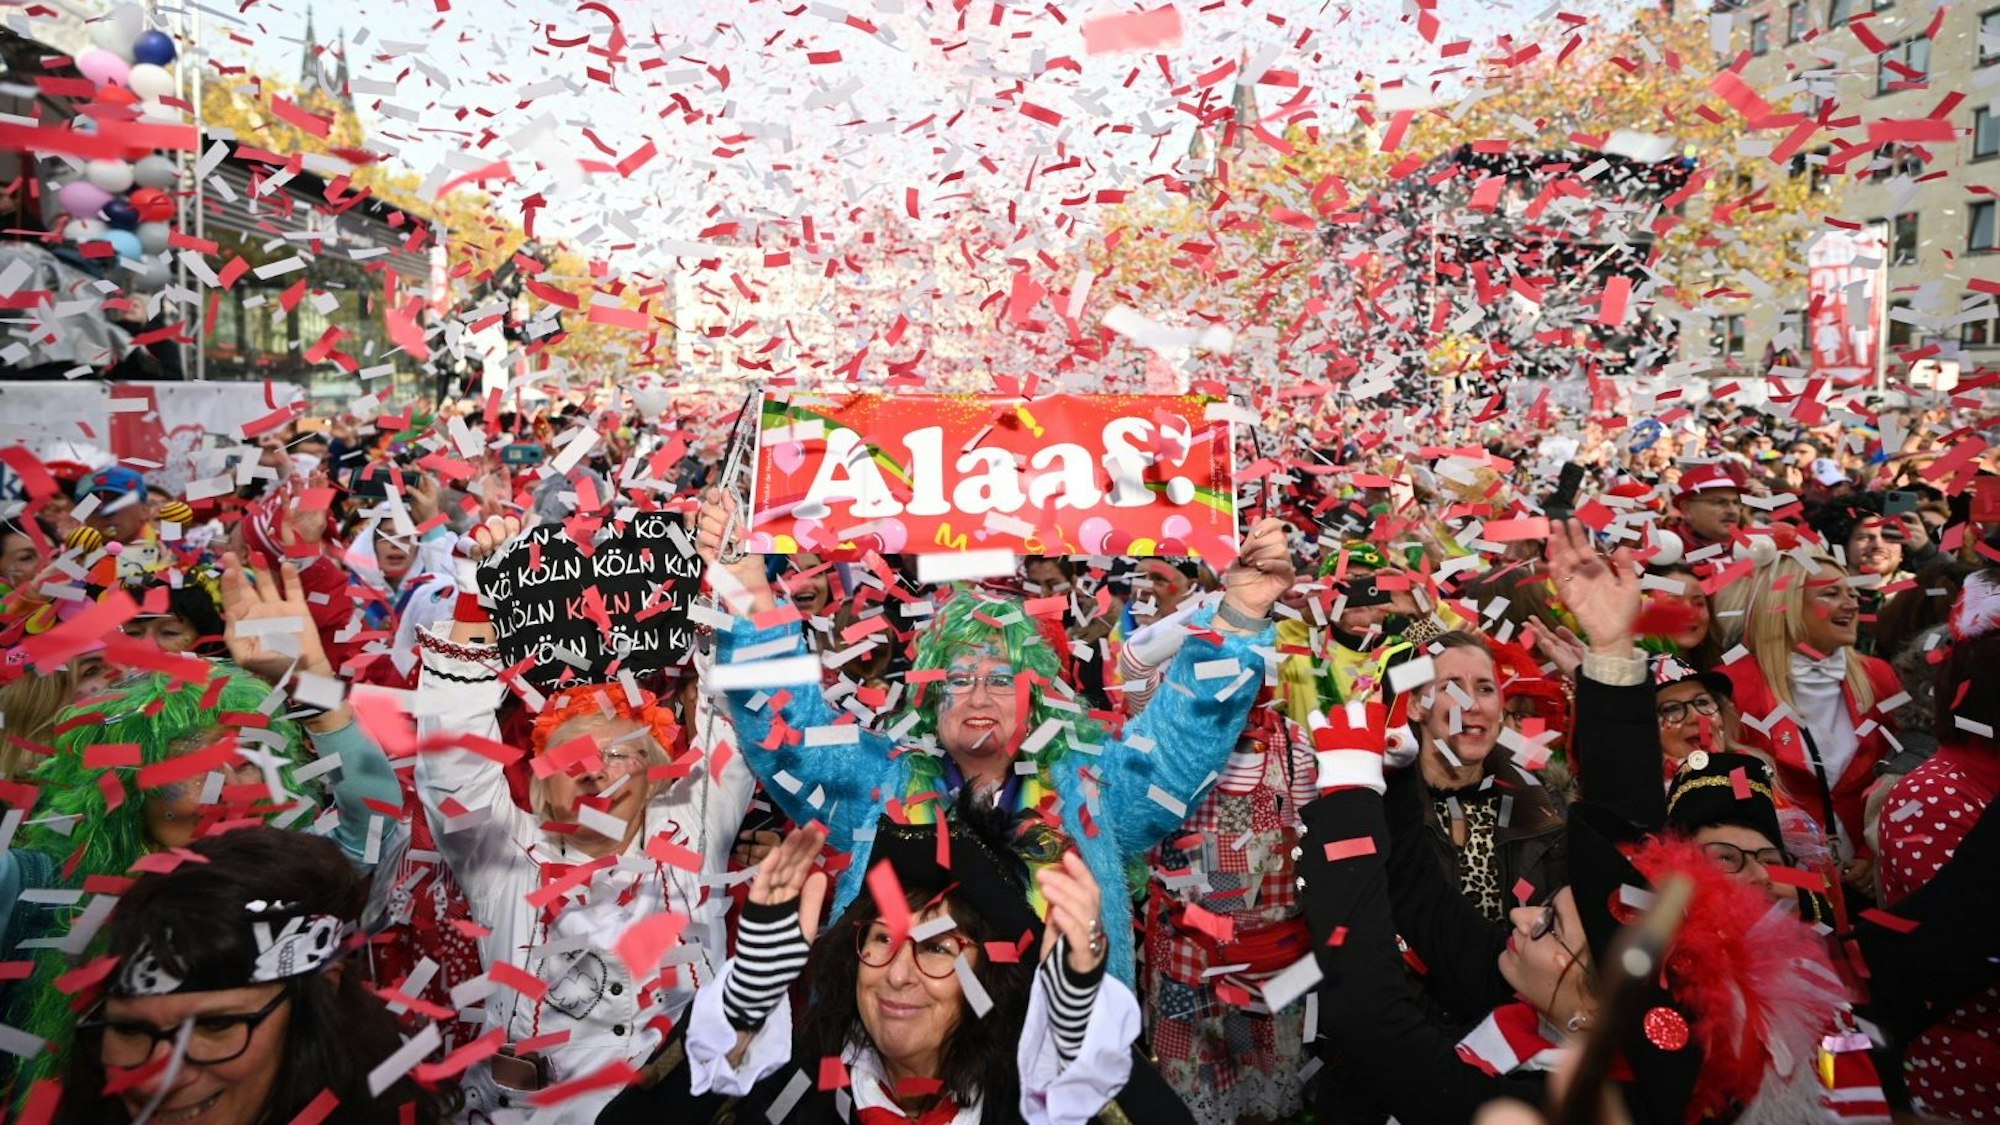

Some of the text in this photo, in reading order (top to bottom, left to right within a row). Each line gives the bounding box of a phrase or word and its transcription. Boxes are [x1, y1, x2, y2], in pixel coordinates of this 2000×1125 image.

[791, 414, 1196, 518] Alaaf!
[518, 556, 581, 588] KÖLN
[592, 548, 656, 577] KÖLN
